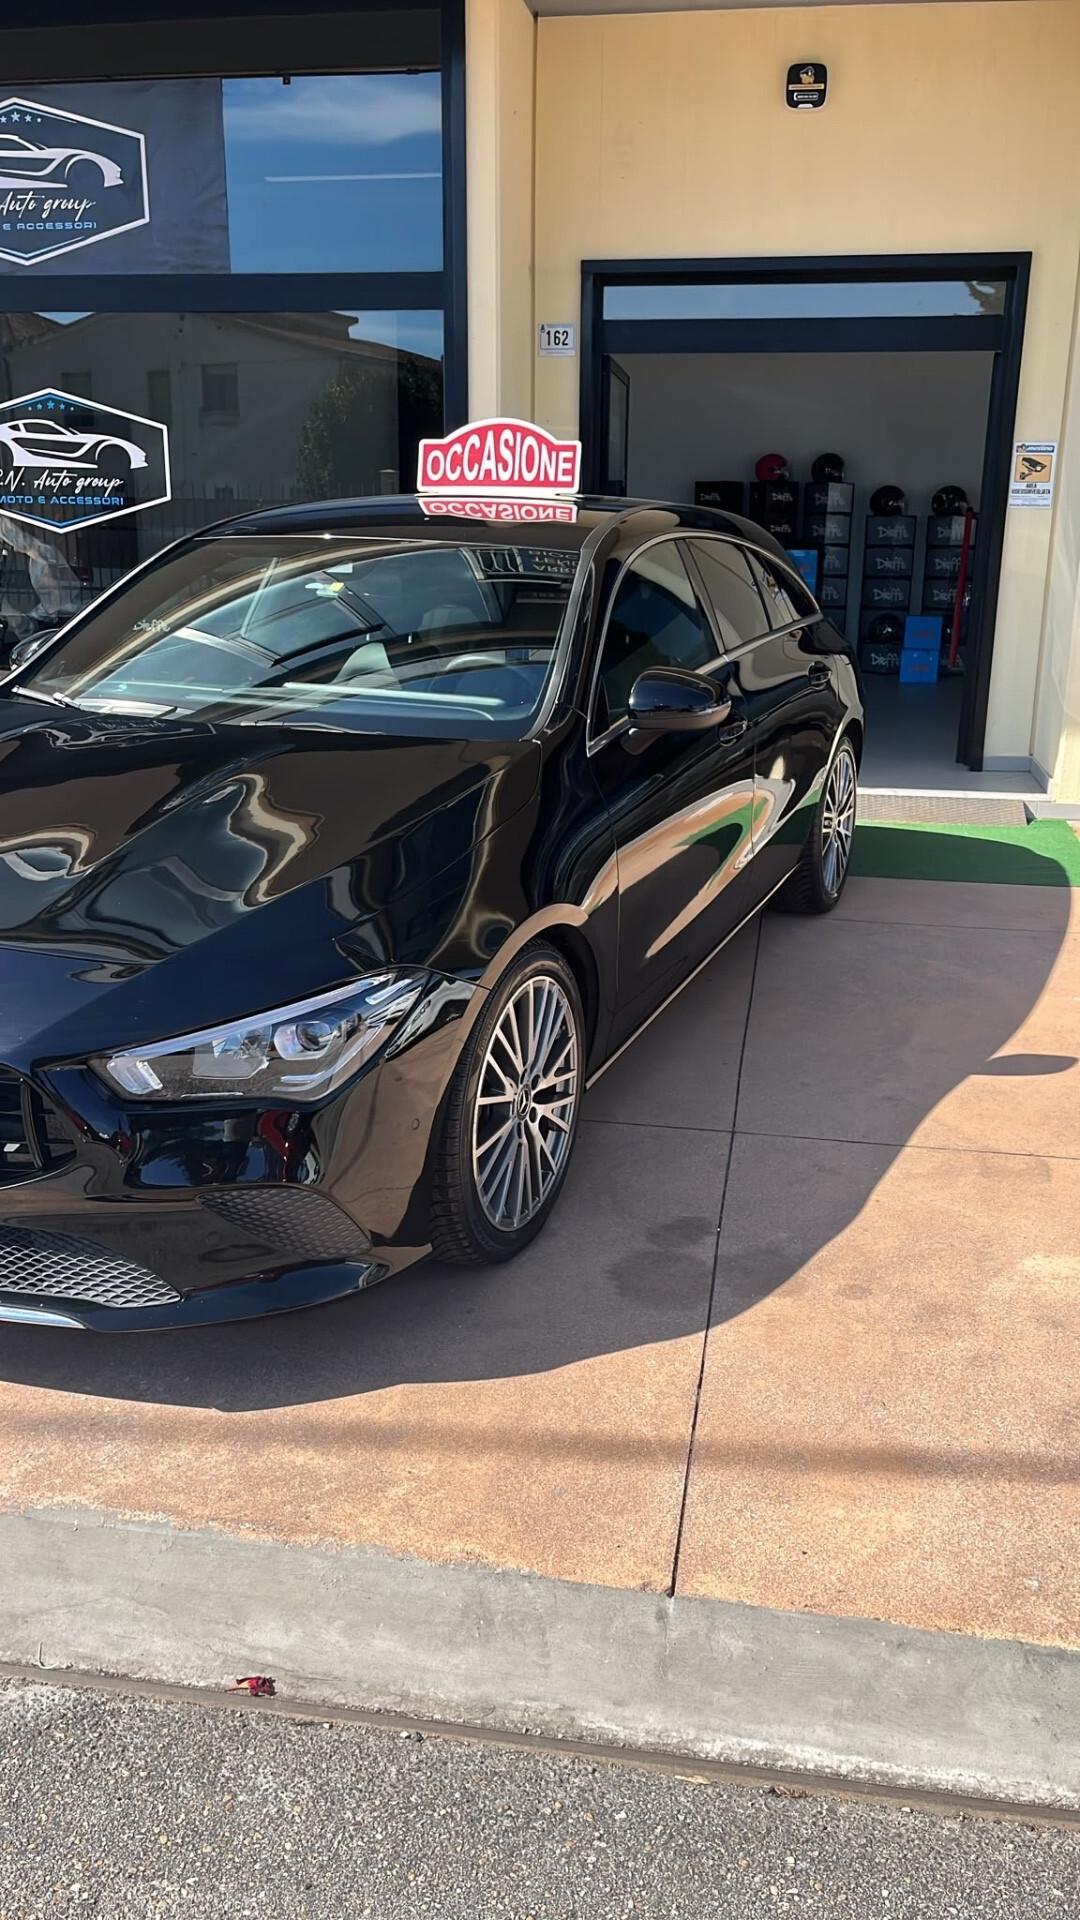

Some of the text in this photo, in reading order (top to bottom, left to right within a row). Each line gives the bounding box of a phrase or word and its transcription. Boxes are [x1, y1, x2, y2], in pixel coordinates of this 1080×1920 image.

[42, 198, 97, 221] group
[16, 222, 97, 231] ACCESSORI
[546, 329, 569, 346] 162
[426, 428, 575, 483] OCCASIONE
[33, 469, 78, 493] Auto
[75, 475, 125, 498] group
[38, 496, 46, 504] E
[50, 496, 124, 505] ACCESSORI
